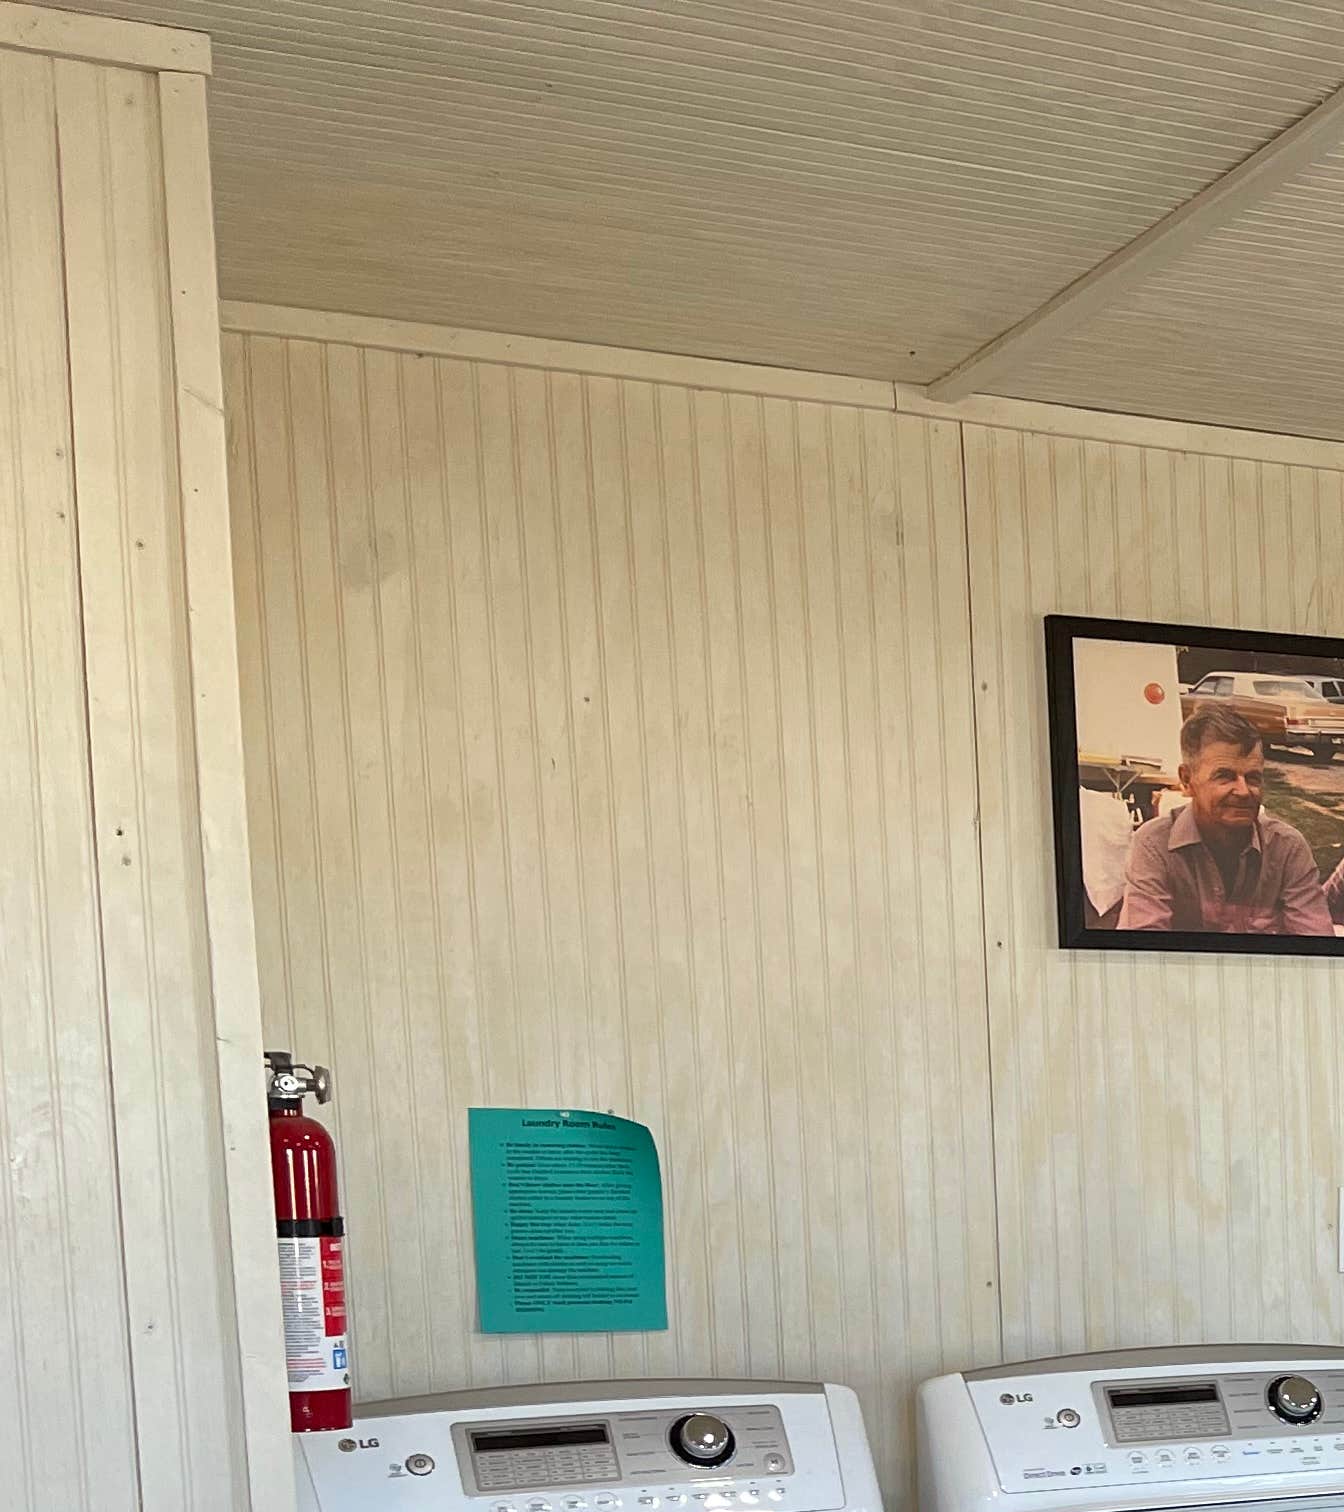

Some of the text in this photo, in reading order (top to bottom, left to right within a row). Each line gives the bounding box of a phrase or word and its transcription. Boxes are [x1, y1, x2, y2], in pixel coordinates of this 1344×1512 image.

[521, 1119, 560, 1129] Laundry
[562, 1120, 590, 1128] Room
[1016, 1393, 1033, 1403] LG
[358, 1438, 380, 1449] LG
